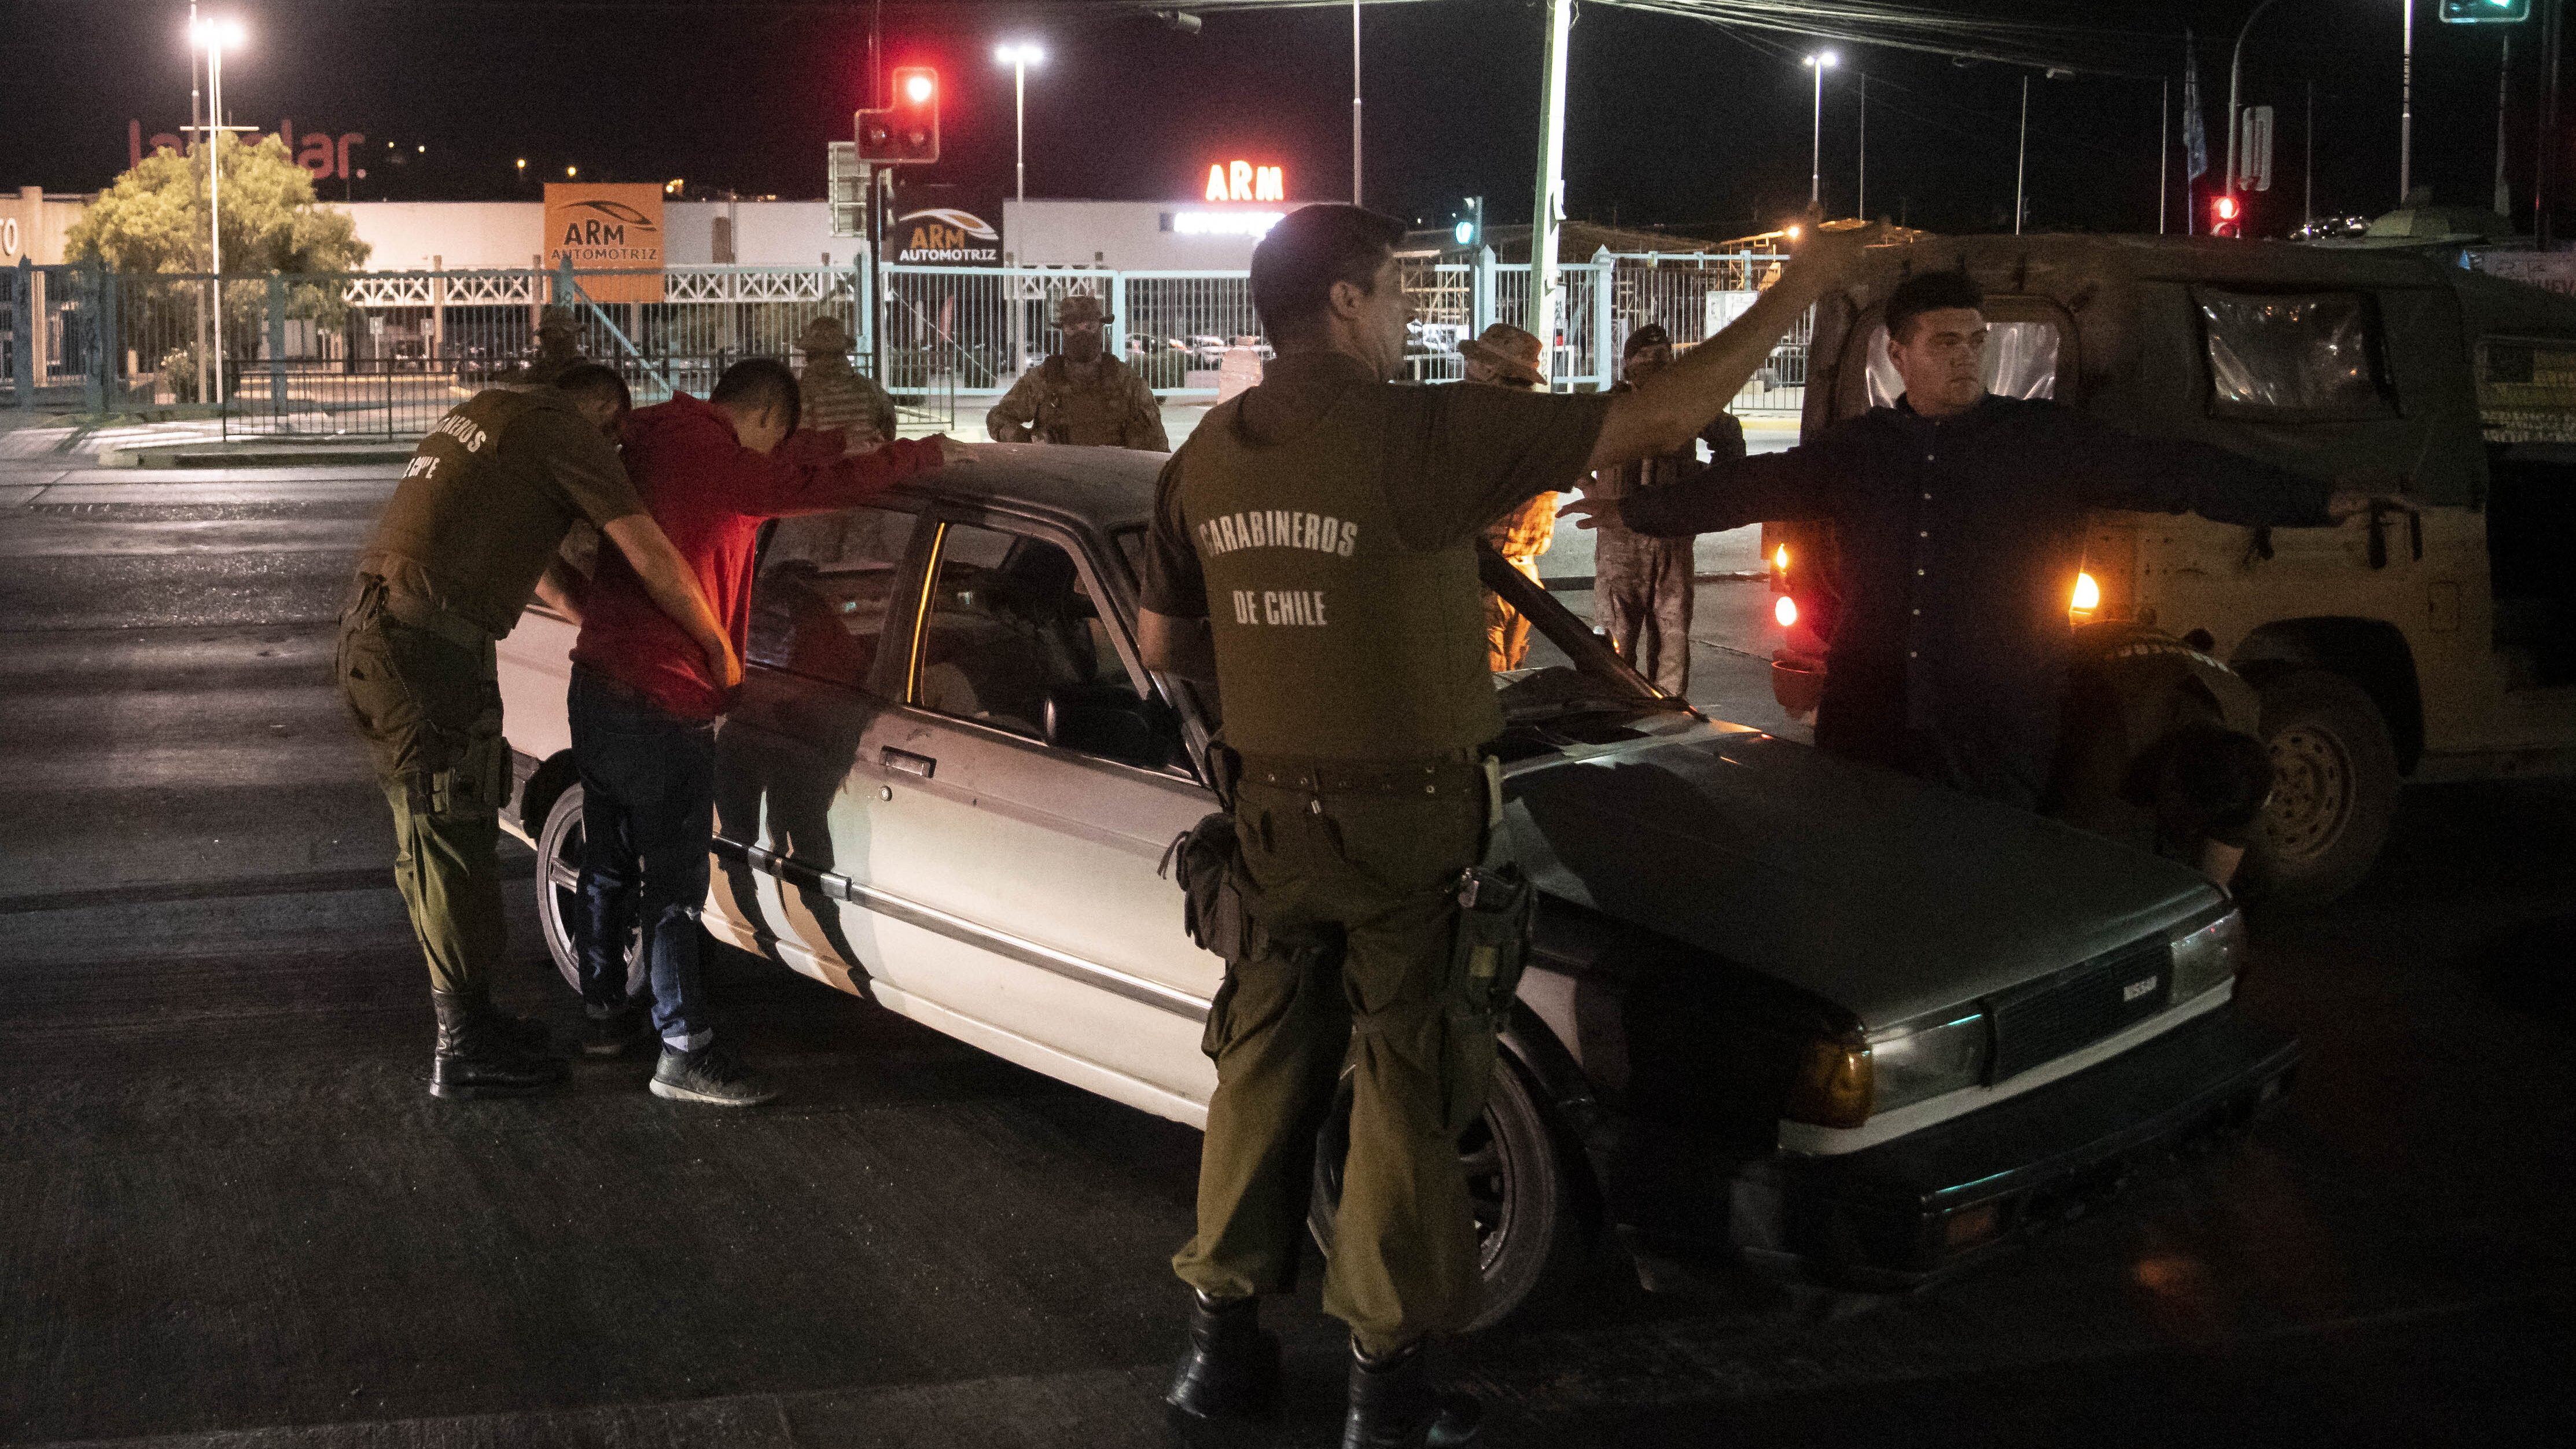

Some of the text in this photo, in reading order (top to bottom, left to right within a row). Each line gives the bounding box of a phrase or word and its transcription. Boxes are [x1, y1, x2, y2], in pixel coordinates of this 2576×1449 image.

[1205, 160, 1283, 201] ARM
[564, 219, 624, 245] ARM
[910, 225, 965, 249] ARM
[551, 249, 657, 260] AUTOMOTRIZ
[900, 249, 996, 261] AUTOMOTRIZ
[1198, 510, 1358, 557] CARABINEROS
[1233, 590, 1327, 626] DE CHILE
